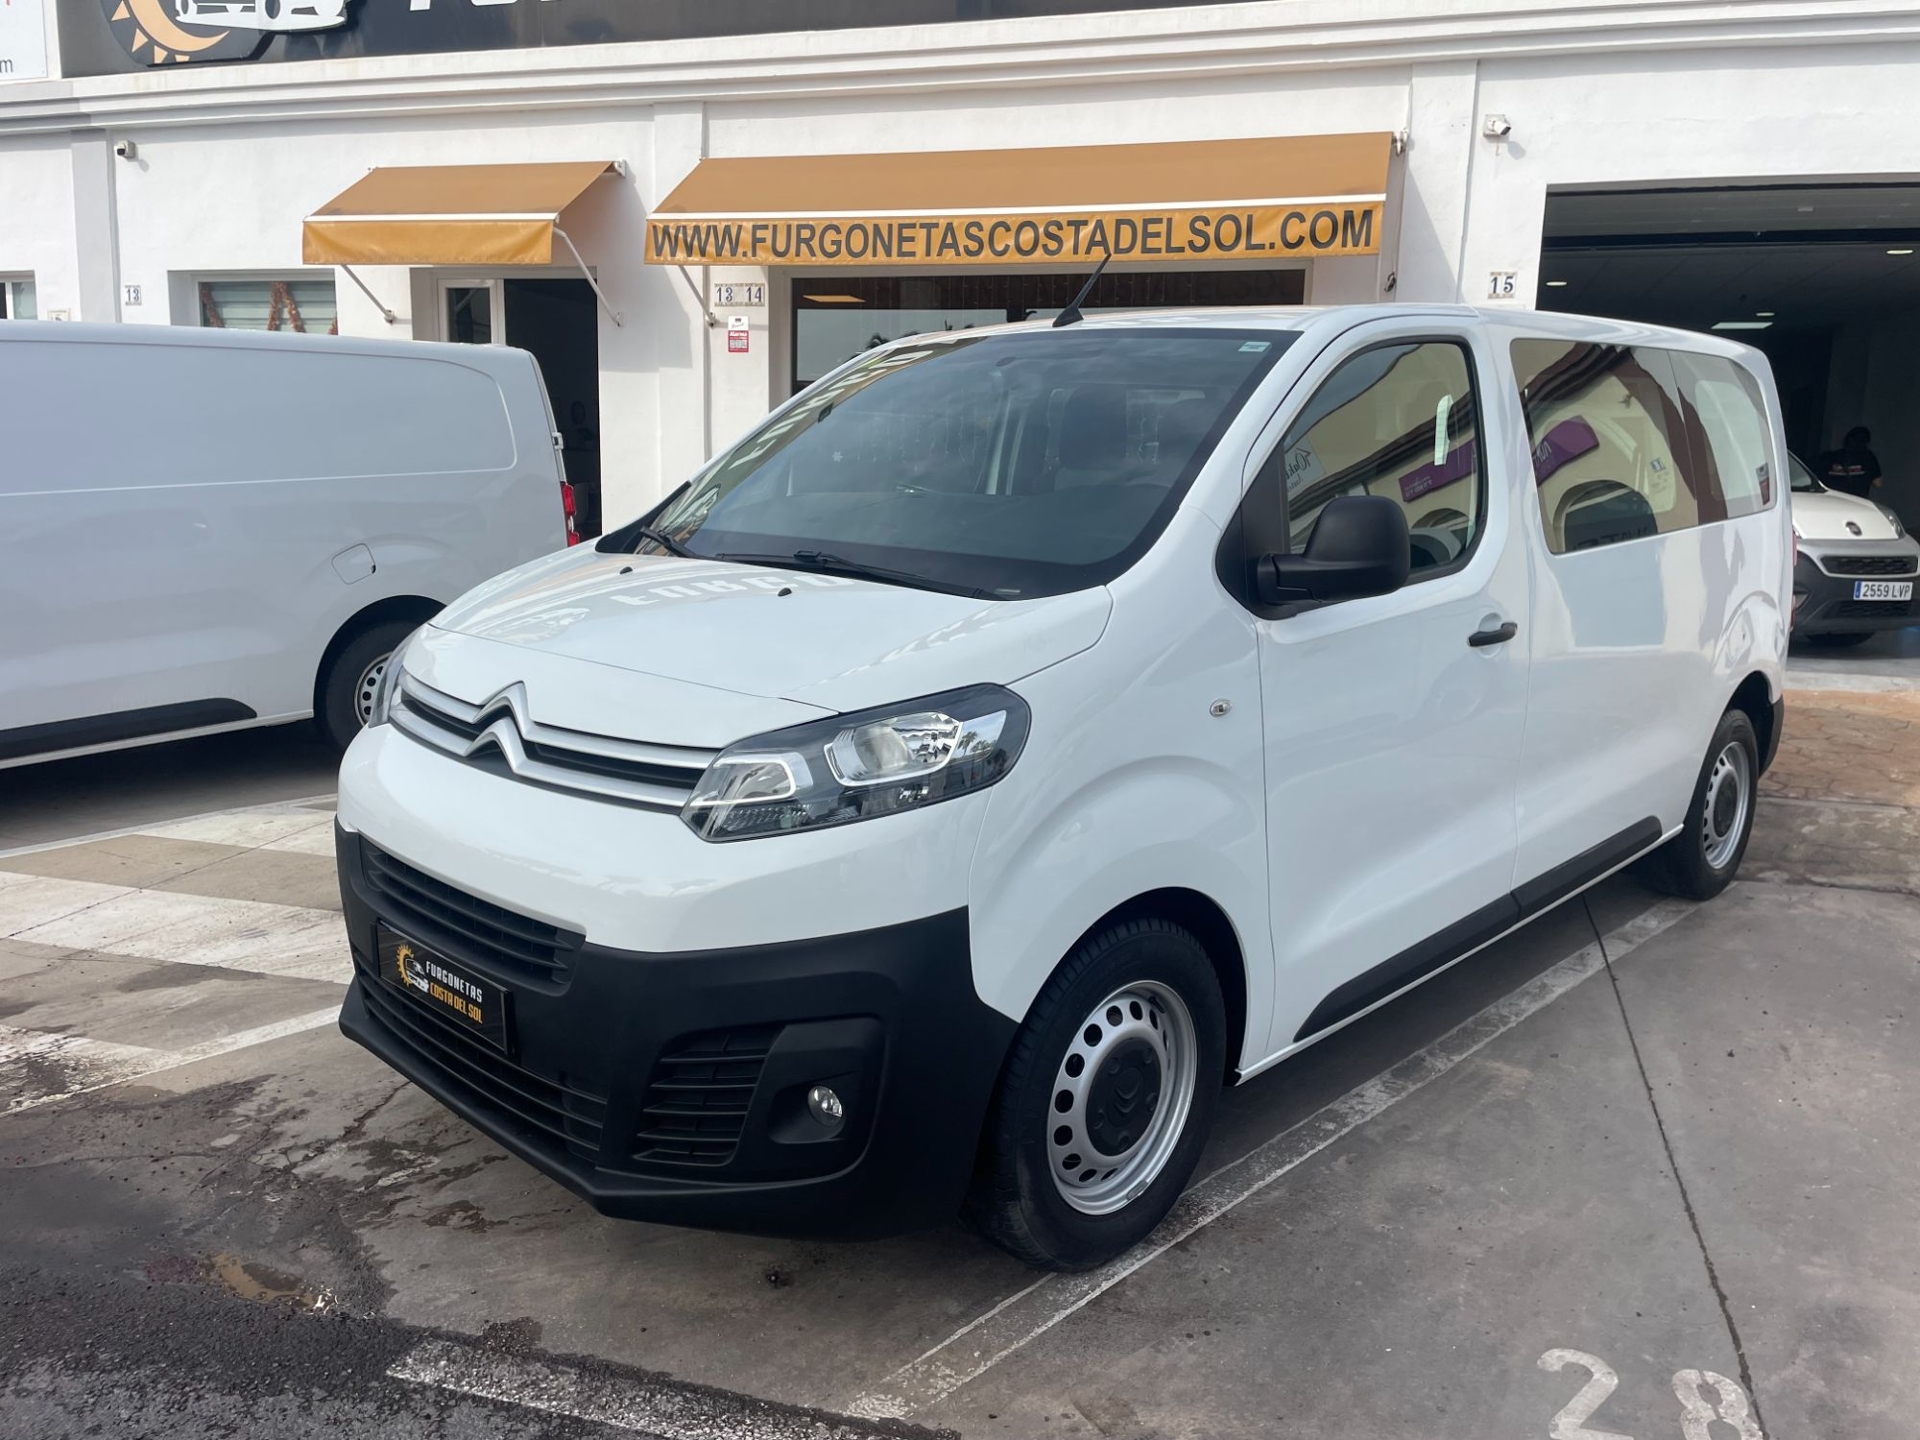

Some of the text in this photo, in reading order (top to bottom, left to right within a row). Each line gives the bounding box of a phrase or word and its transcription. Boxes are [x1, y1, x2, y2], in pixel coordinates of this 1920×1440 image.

[651, 209, 1372, 259] WWW.FURGONETASCOSTADELSOL.COM
[126, 287, 140, 302] 13
[716, 286, 762, 302] 13 14
[1490, 276, 1514, 294] 15
[1862, 584, 1911, 598] 2559 LVP
[426, 961, 483, 1003] FURGONETAS
[429, 982, 483, 1024] COSTA DEL SOL
[1537, 1348, 1764, 1440] 28
